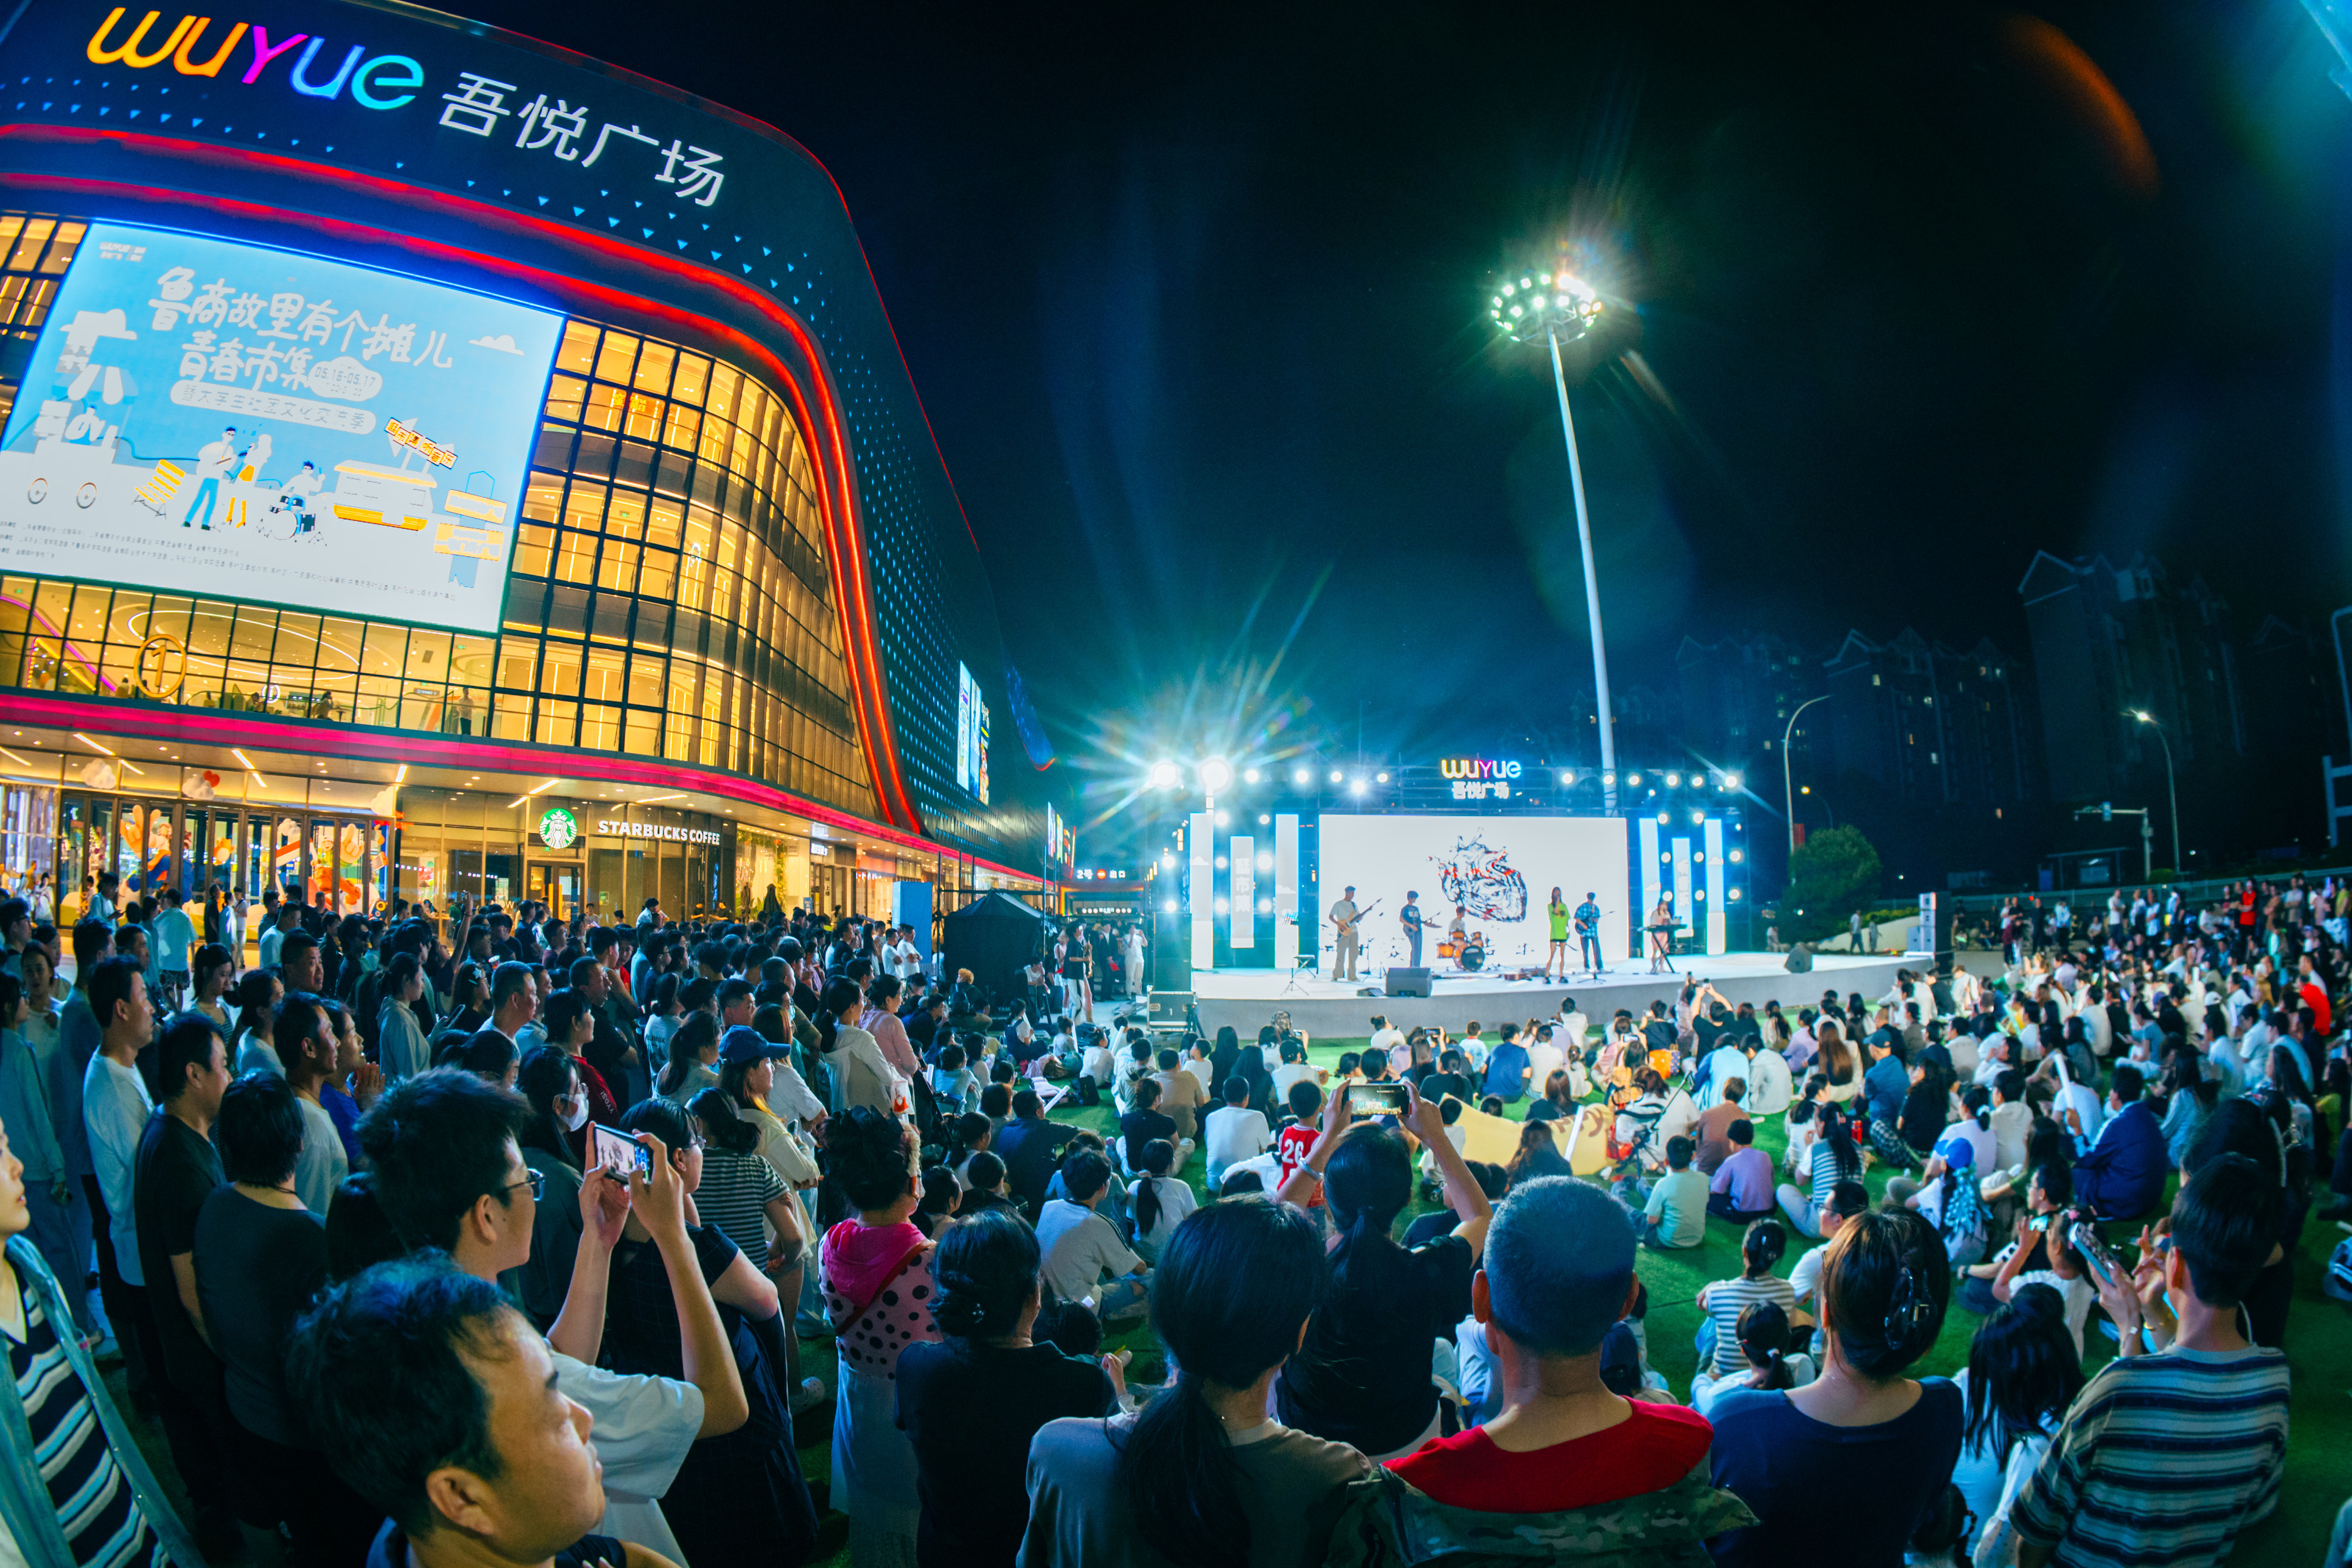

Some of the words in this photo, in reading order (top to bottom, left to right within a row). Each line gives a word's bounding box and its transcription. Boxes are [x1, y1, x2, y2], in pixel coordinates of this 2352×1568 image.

[439, 72, 724, 206] 吾悦广场
[148, 266, 453, 369] 鲁商故里有个摊儿
[179, 330, 314, 391] 青春市集
[315, 366, 376, 387] 05.16-05.17
[1452, 781, 1509, 800] 吾悦广场
[598, 820, 689, 841] STARBUCKS
[689, 829, 720, 845] COFFEE
[1077, 869, 1093, 880] 2号
[1110, 870, 1125, 878] 出口
[1169, 1008, 1173, 1016] 1
[1283, 1138, 1304, 1166] 26
